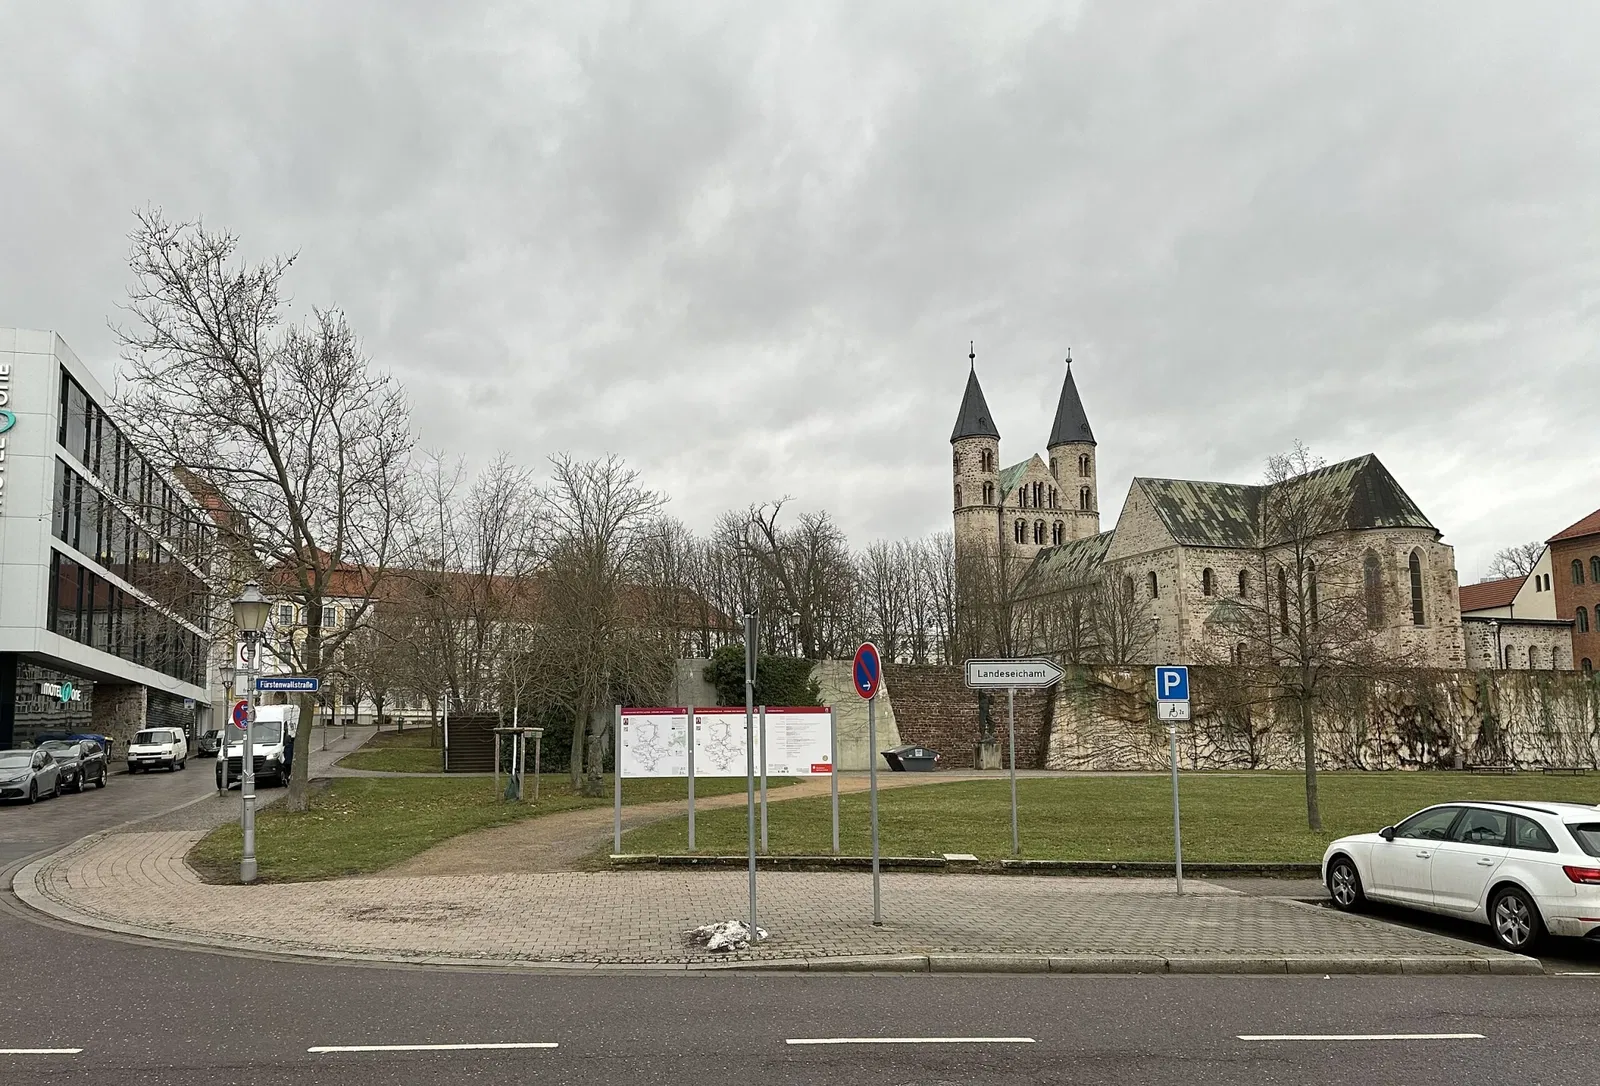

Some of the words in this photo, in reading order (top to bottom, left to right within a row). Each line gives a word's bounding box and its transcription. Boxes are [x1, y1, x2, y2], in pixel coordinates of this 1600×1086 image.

[977, 669, 1046, 678] Landeseichamt
[260, 680, 314, 689] Fürstenwallstraße
[1164, 671, 1181, 696] P
[42, 682, 63, 698] MOTEL
